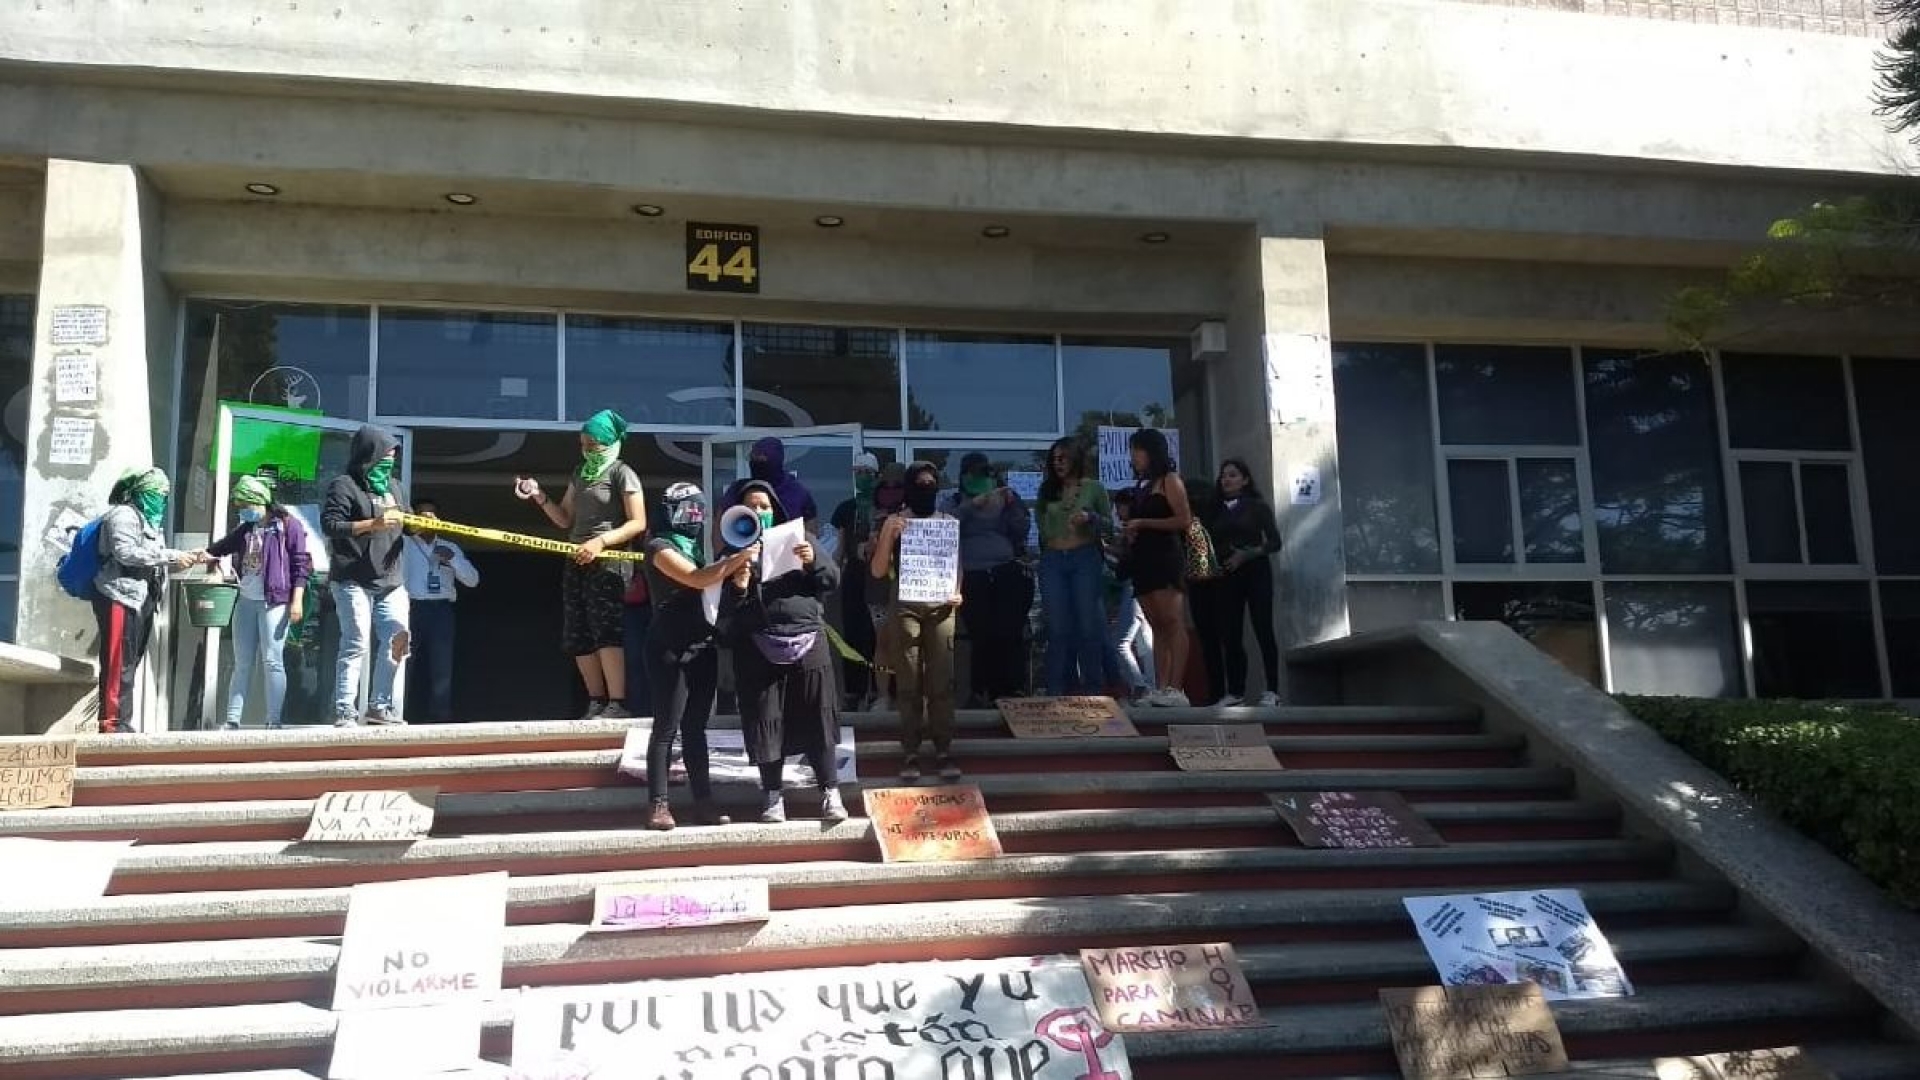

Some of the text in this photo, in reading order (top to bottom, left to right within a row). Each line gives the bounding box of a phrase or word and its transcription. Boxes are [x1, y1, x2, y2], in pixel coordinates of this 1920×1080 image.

[695, 228, 752, 241] EDIFICIO
[689, 244, 757, 283] 44
[383, 950, 430, 974] NO
[1086, 949, 1188, 976] MARCHO
[346, 972, 480, 999] VIOLARME
[1103, 983, 1159, 1004] PARA
